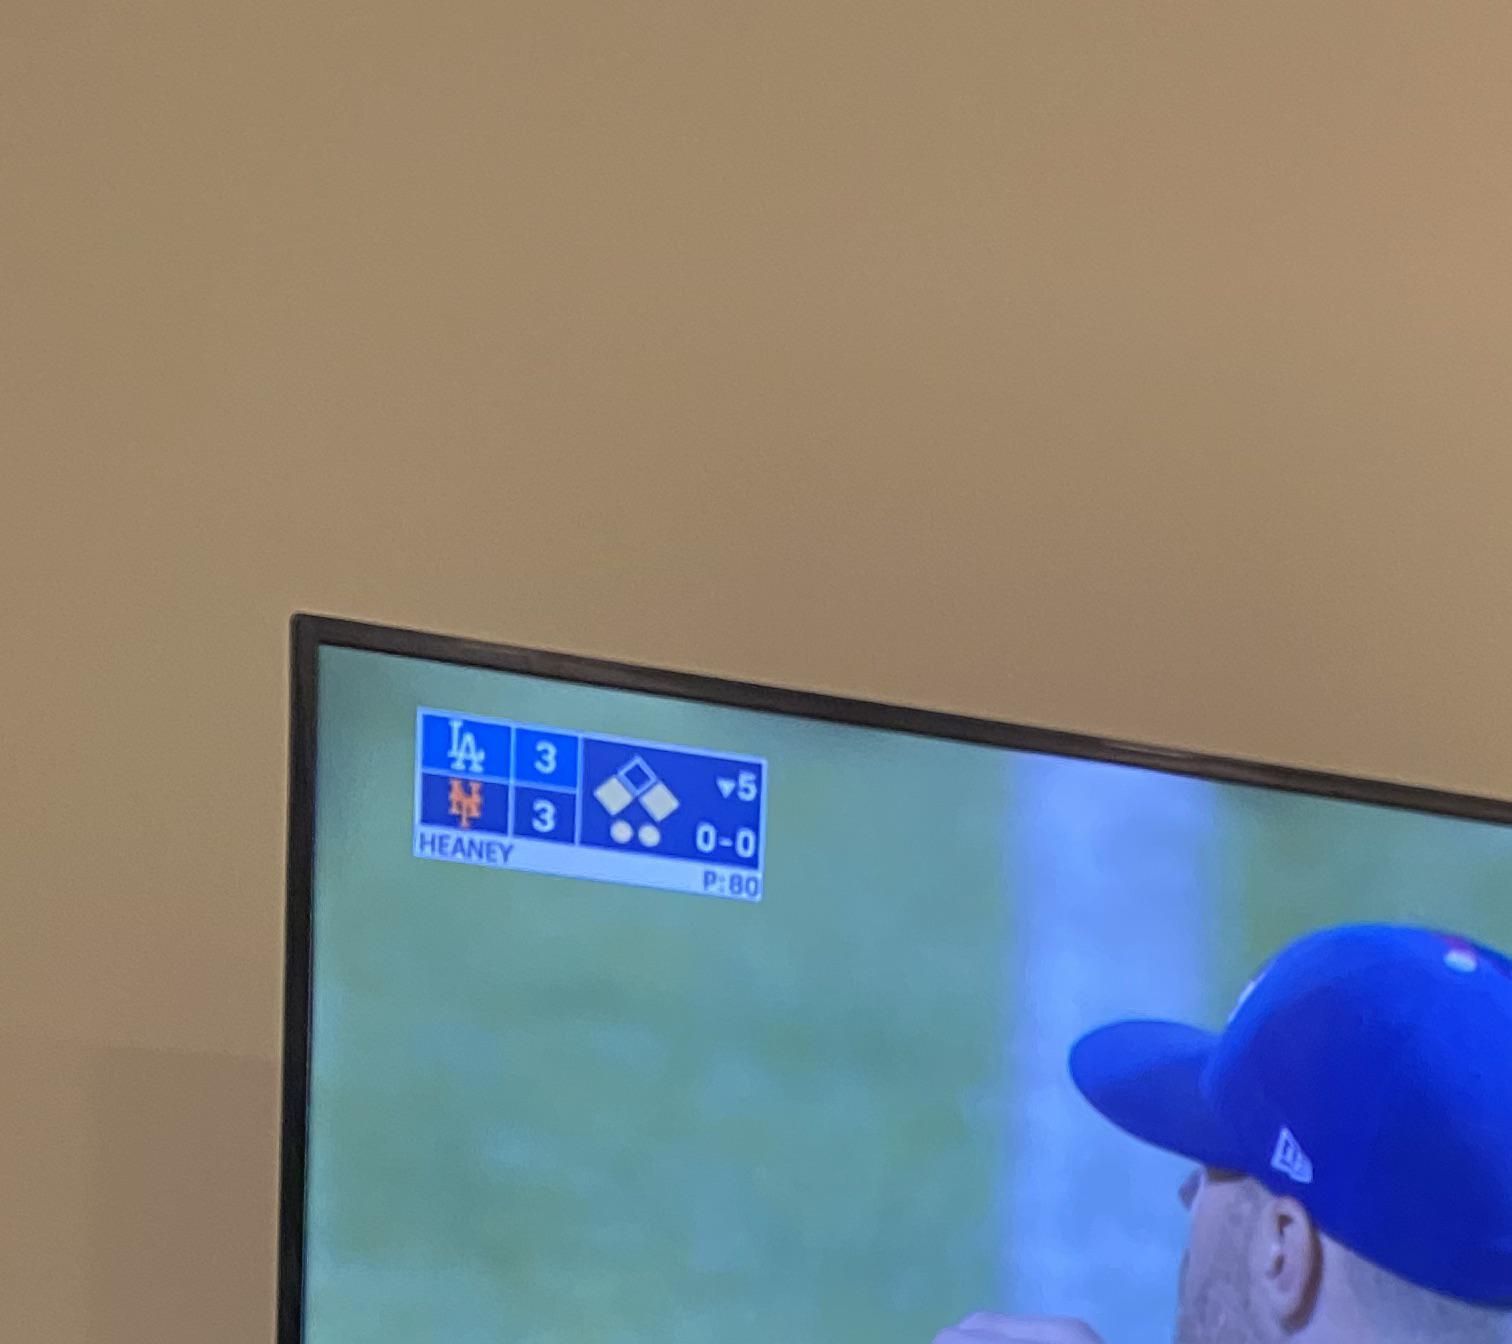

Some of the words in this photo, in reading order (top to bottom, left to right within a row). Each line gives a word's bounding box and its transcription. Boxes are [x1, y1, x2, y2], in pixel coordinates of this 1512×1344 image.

[448, 719, 486, 773] LA
[533, 741, 558, 775] 3
[736, 771, 758, 802] 5
[531, 799, 557, 833] 3
[418, 832, 515, 865] HEANEY
[695, 822, 757, 859] 0-0
[702, 869, 761, 897] P:80
